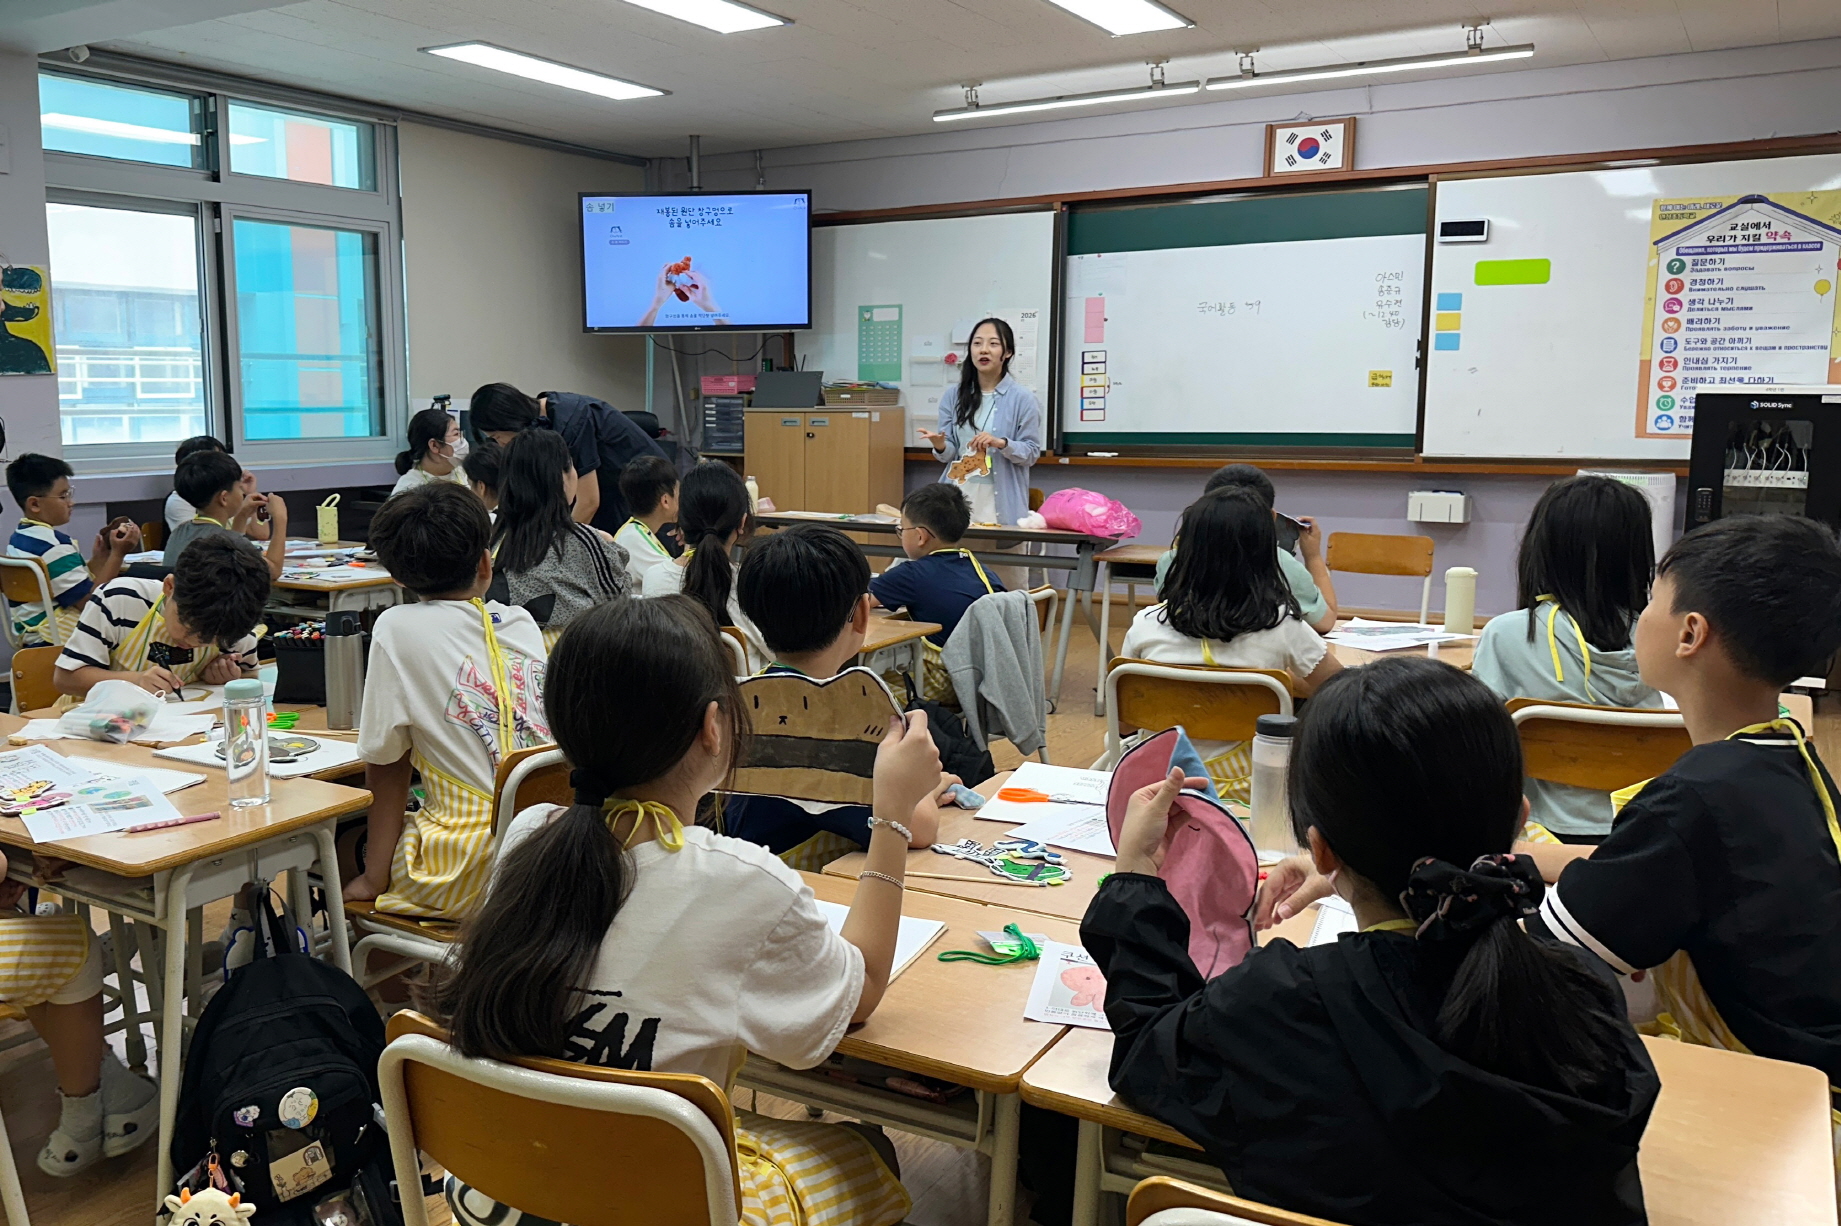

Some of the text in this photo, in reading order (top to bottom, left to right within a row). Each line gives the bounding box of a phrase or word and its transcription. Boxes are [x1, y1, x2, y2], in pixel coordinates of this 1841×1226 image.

[598, 203, 614, 213] 넣기
[656, 207, 734, 217] 재봉된 원단 창구멍으로
[685, 218, 722, 229] 넣어주세요
[1728, 221, 1772, 232] 교실에서
[1706, 230, 1792, 243] 우리가 지킬 약속
[1691, 258, 1725, 267] 질문하기
[1690, 278, 1724, 286] 경청하기
[1688, 297, 1734, 306] 생각 나누기
[1686, 317, 1721, 325] 배려하기
[1685, 337, 1708, 345] 도구와
[1710, 337, 1725, 345] 공간
[1683, 356, 1738, 365] 인내심 가지기
[1682, 376, 1715, 384] 준비하고
[1748, 376, 1774, 384] 다하기
